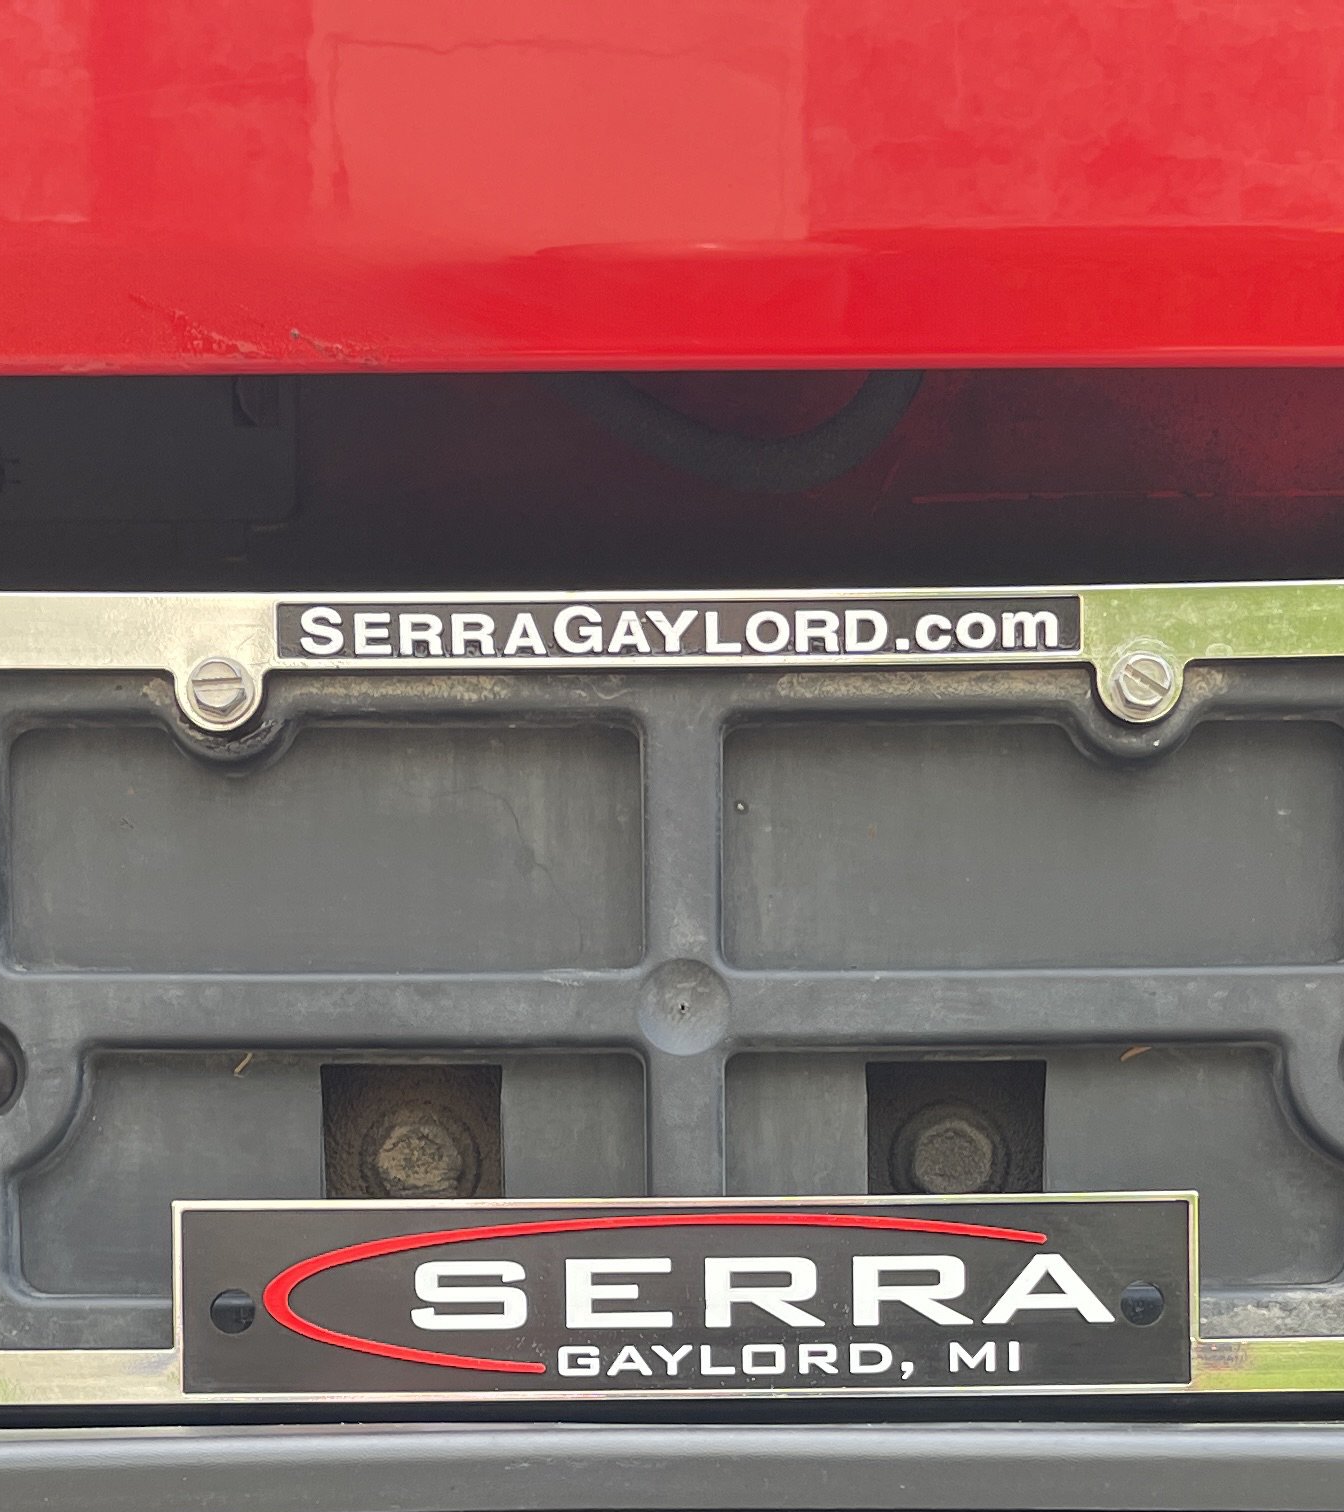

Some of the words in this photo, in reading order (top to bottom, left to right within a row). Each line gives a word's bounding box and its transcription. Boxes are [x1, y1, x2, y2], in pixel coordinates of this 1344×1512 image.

[299, 605, 1060, 657] SERRAGAYLORD.com
[410, 1253, 1117, 1331] SERRA
[557, 1342, 915, 1380] GAYLORD,
[949, 1340, 1022, 1373] MI
